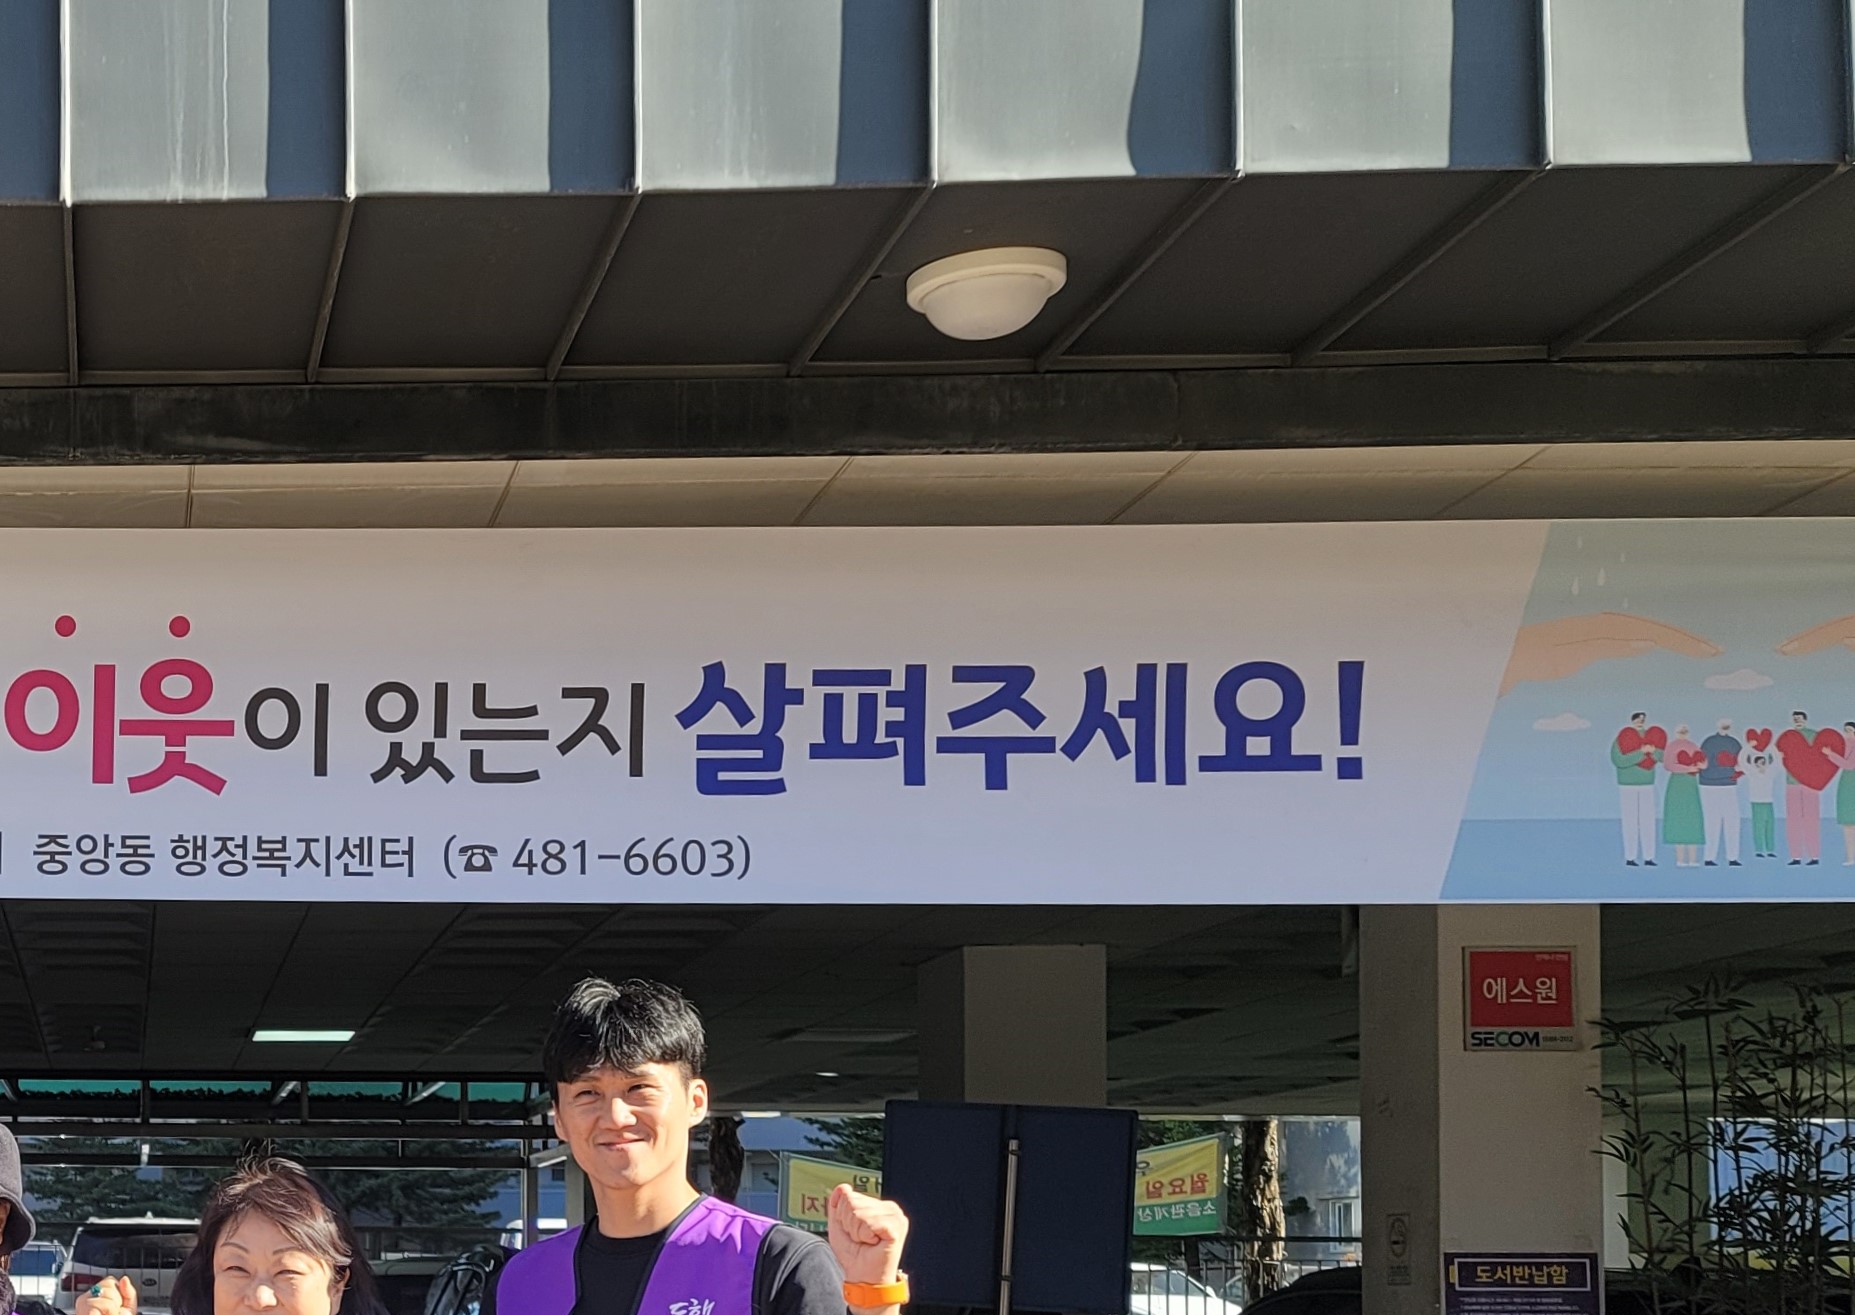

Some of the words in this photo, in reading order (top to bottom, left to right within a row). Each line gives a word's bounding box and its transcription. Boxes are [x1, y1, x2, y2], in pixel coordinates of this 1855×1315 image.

[4, 658, 327, 796] 이웃이
[365, 681, 644, 784] 있는지
[675, 659, 1366, 796] 살펴주세요!
[32, 832, 155, 876] 중앙동
[170, 832, 415, 878] 행정복지센터
[1483, 977, 1558, 1004] 에스원
[1470, 1031, 1540, 1047] SECOM
[1475, 1265, 1569, 1285] 도서반납함
